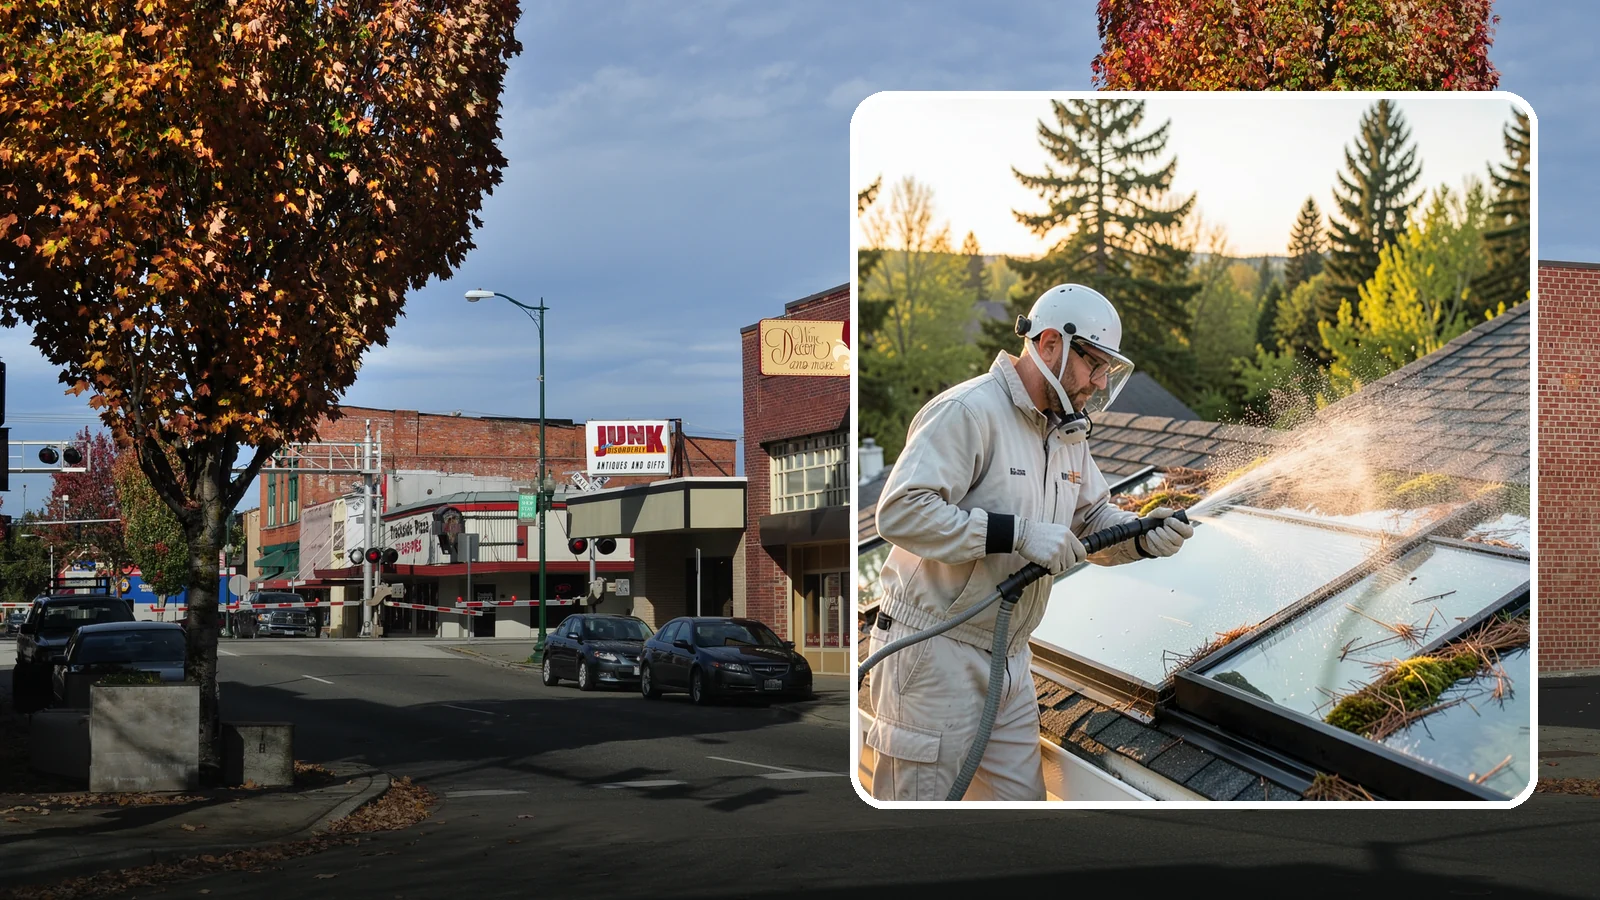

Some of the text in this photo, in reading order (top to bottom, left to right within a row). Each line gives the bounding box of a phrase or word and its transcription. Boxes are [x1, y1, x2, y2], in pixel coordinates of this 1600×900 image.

[765, 328, 831, 365] Decor
[595, 425, 665, 457] JUNK
[607, 446, 646, 454] DISORDERLY
[597, 461, 665, 470] ANTIQUES AND GIFTS
[352, 498, 365, 511] CRO
[390, 519, 429, 540] Trackside Pizza
